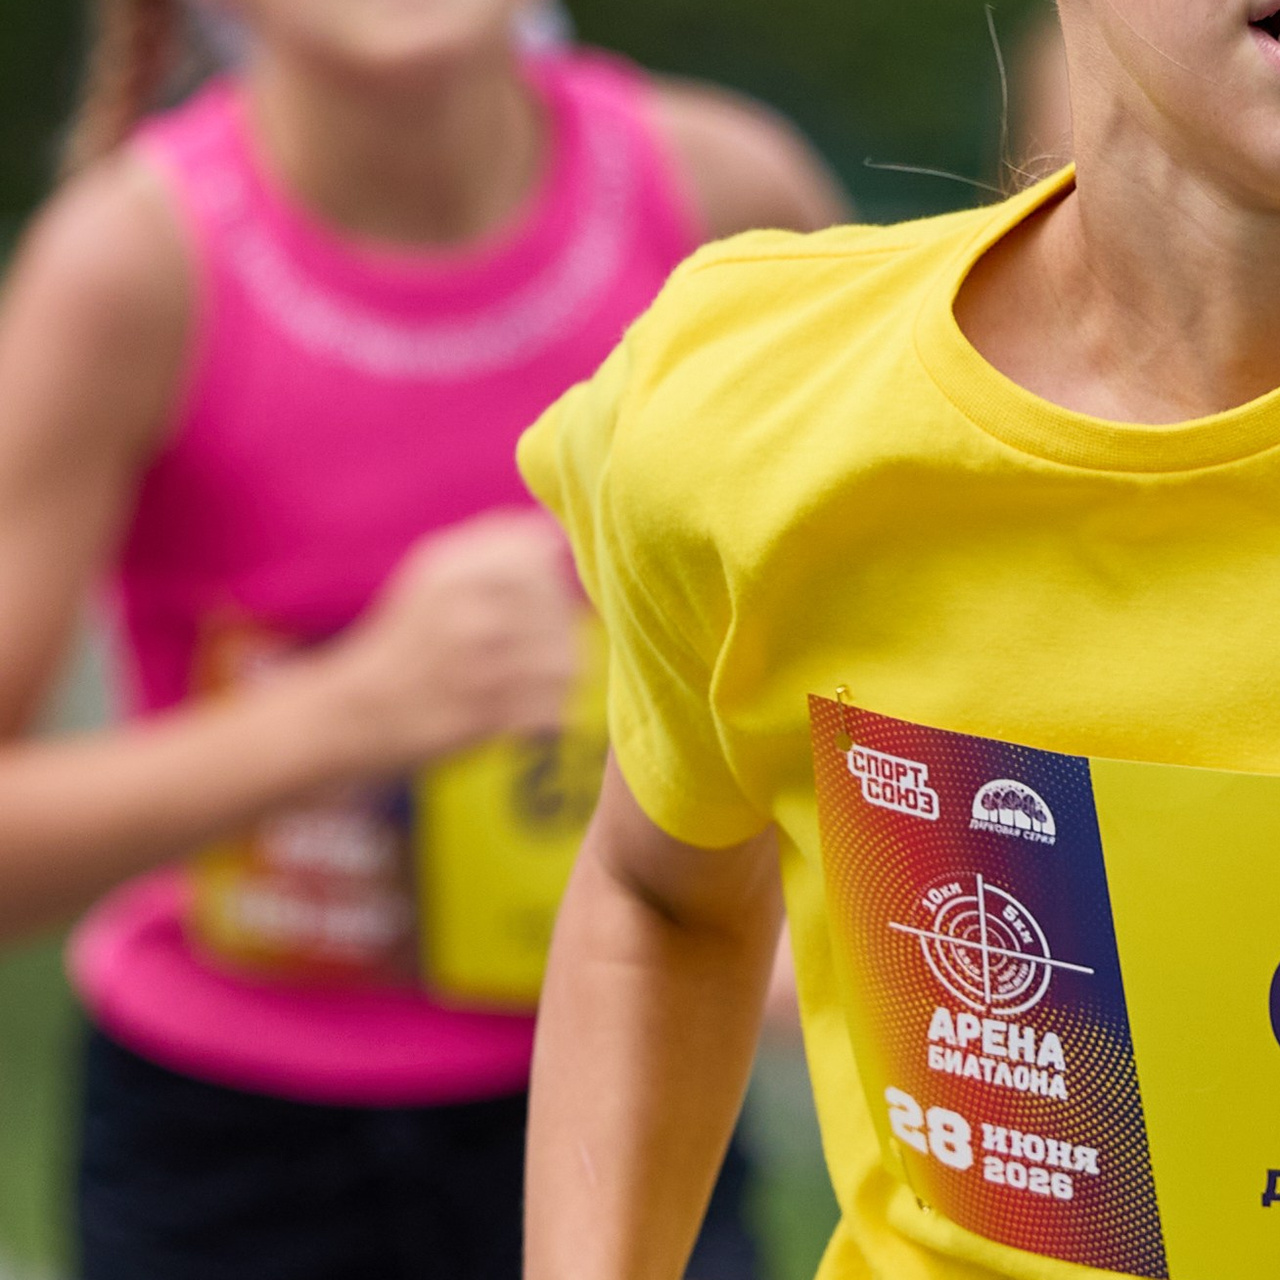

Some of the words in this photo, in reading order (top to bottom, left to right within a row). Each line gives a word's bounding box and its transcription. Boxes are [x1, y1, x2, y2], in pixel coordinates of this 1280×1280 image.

[852, 750, 923, 788] СПОРТ
[866, 777, 934, 814] СОЮЗ
[927, 1006, 1067, 1072] АРЕНА
[927, 1044, 1068, 1101] БИАТЛОНА
[884, 1085, 974, 1172] 28
[983, 1155, 1074, 1201] 2026
